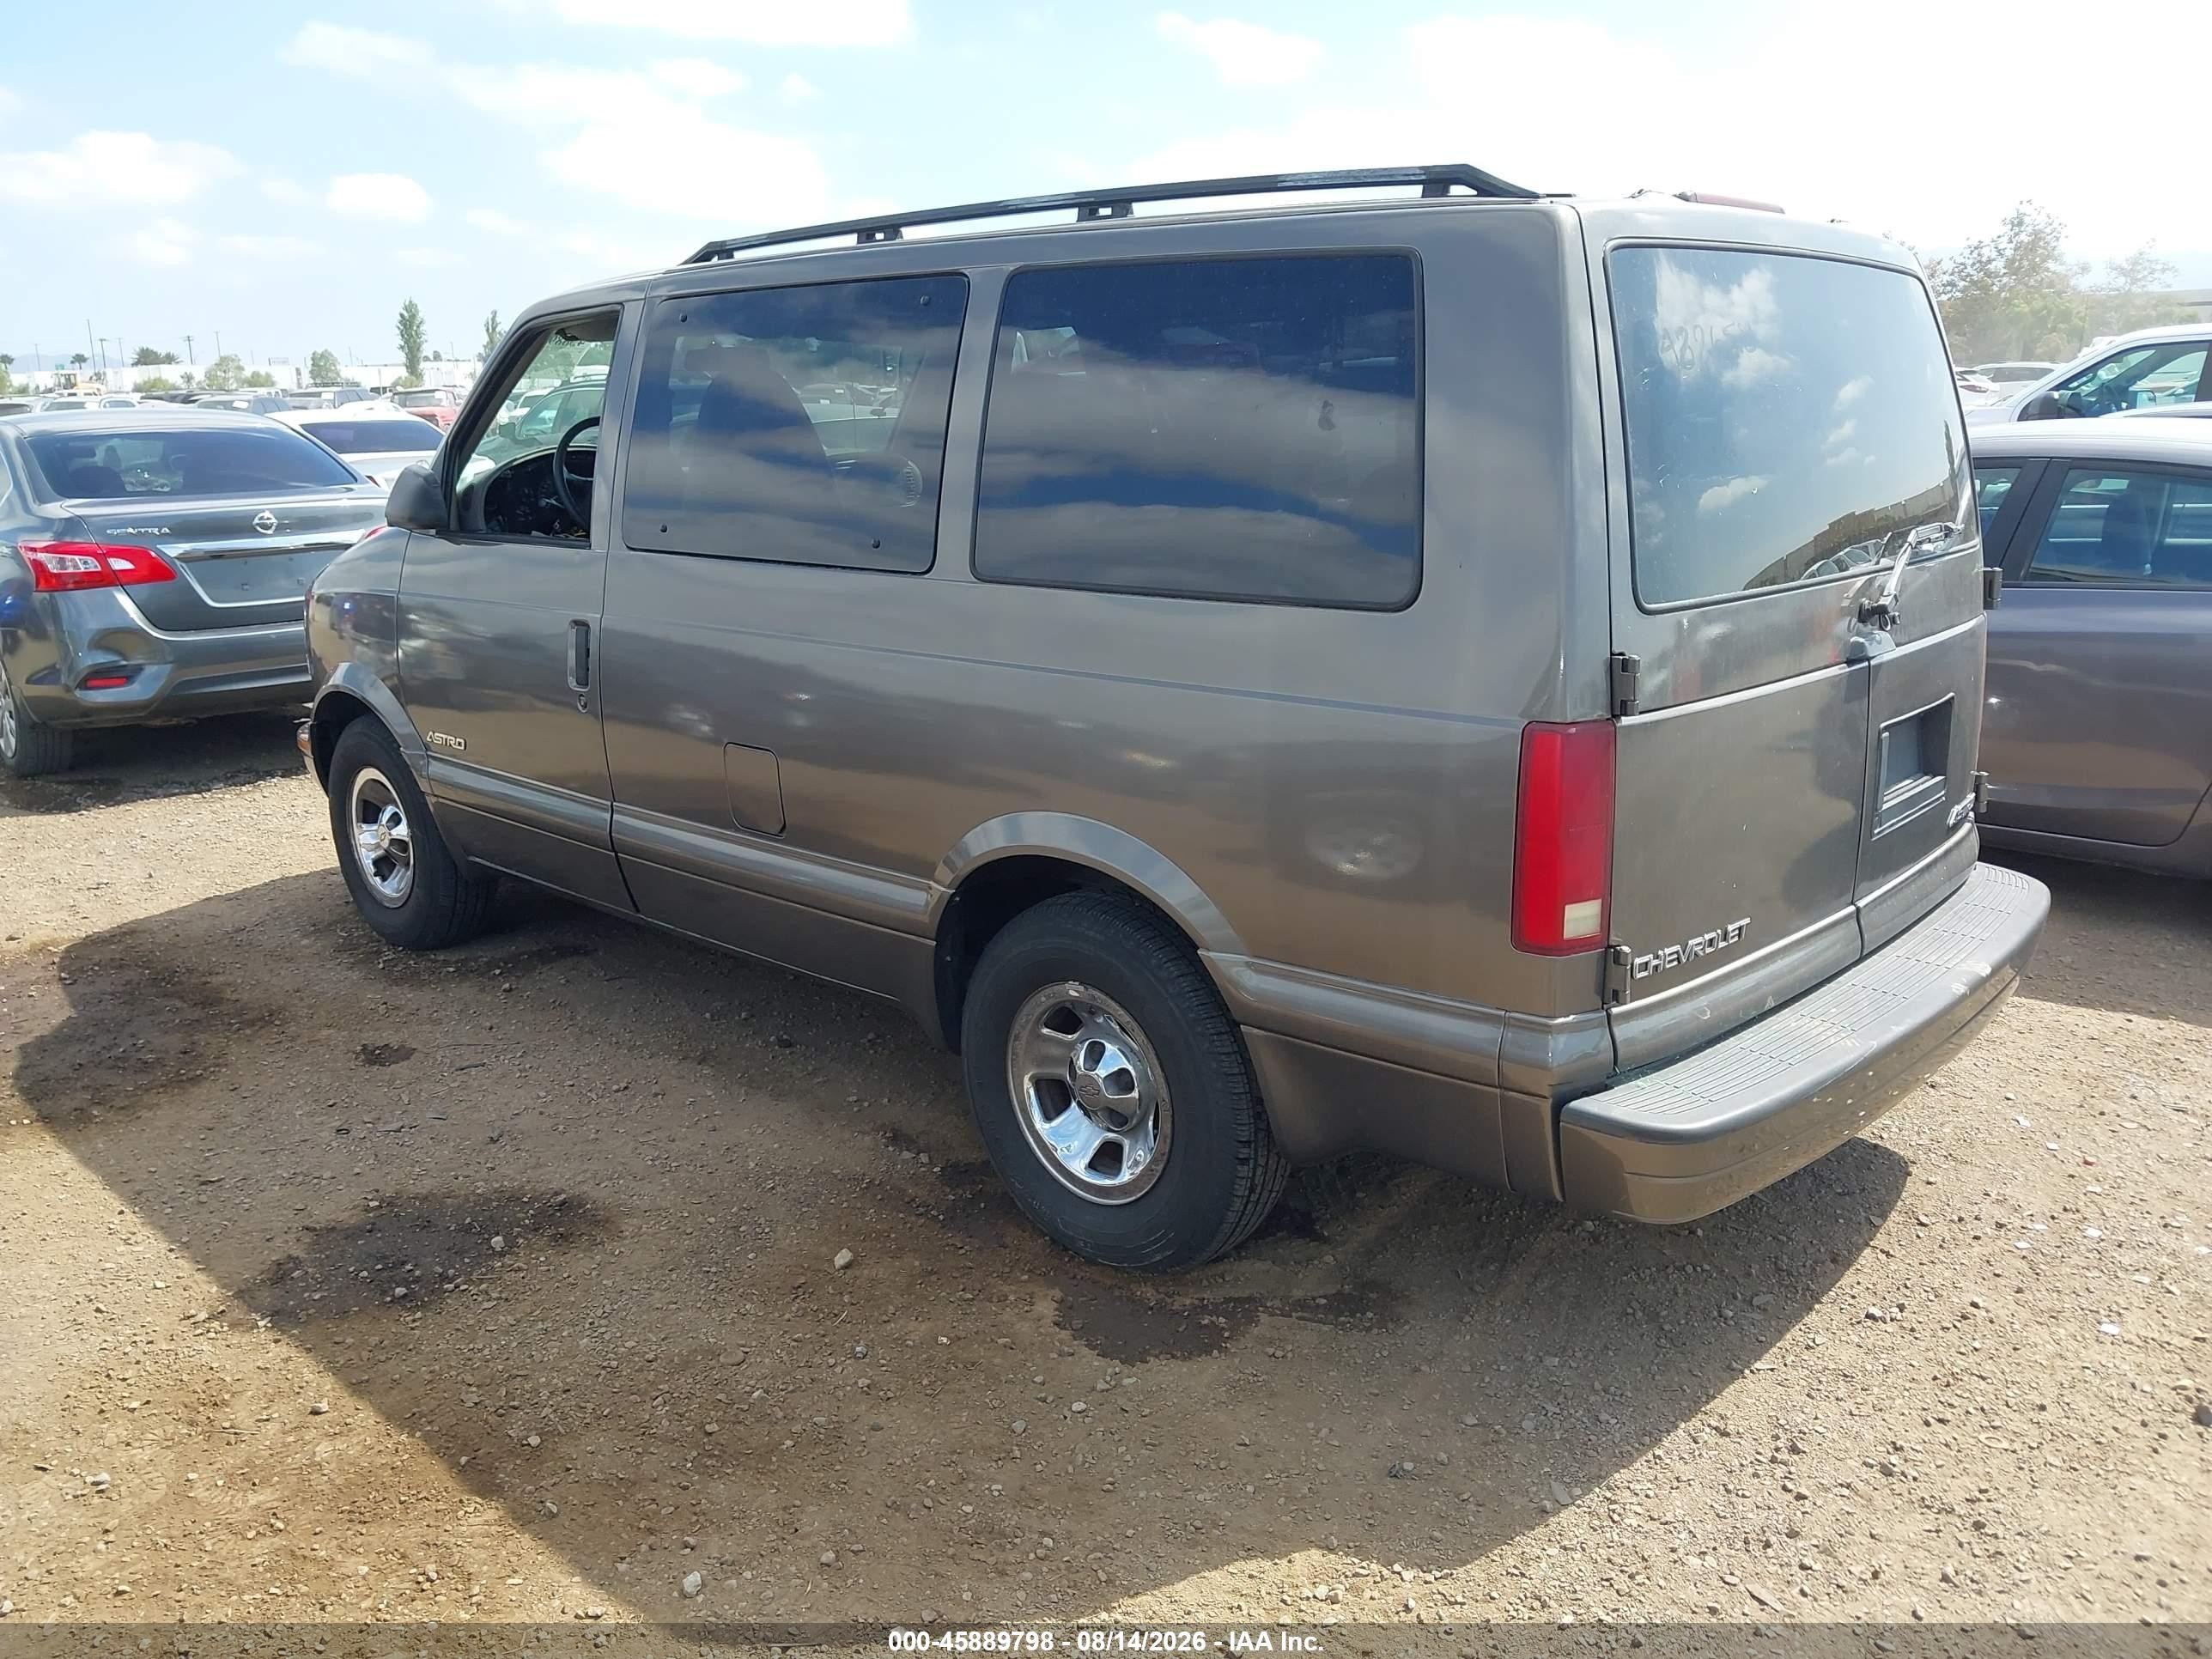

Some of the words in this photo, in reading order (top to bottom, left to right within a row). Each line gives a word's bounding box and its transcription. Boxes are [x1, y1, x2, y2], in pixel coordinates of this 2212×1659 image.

[106, 526, 173, 537] SENTRA
[426, 731, 466, 750] ASTRO
[1633, 917, 1751, 979] CHEVROLET
